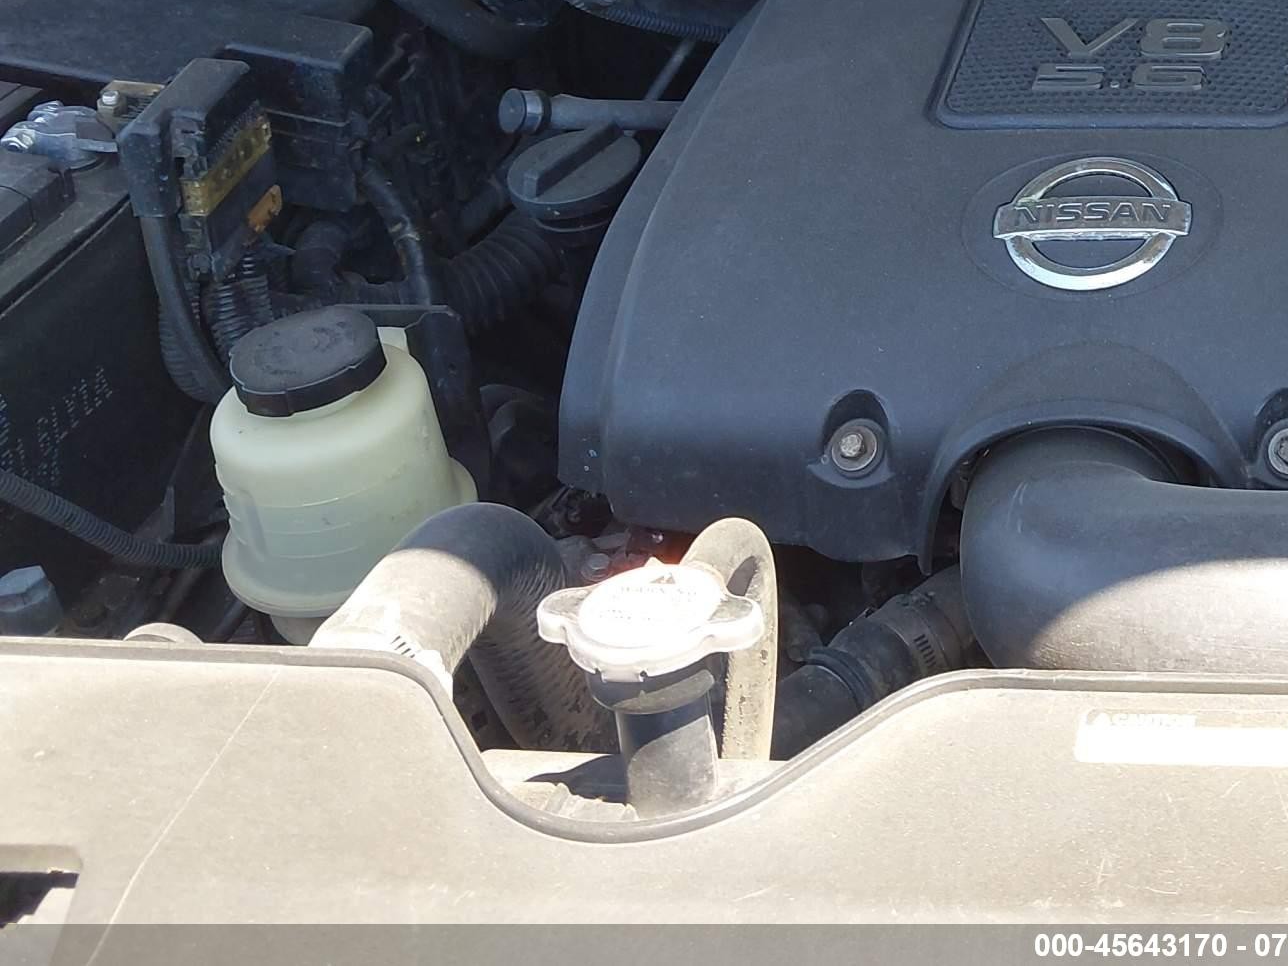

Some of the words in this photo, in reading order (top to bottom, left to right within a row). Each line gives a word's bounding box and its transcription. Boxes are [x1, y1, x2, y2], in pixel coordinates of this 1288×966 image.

[1040, 17, 1228, 60] V8
[1031, 62, 1207, 91] 5.6
[1013, 202, 1171, 224] NISSAN
